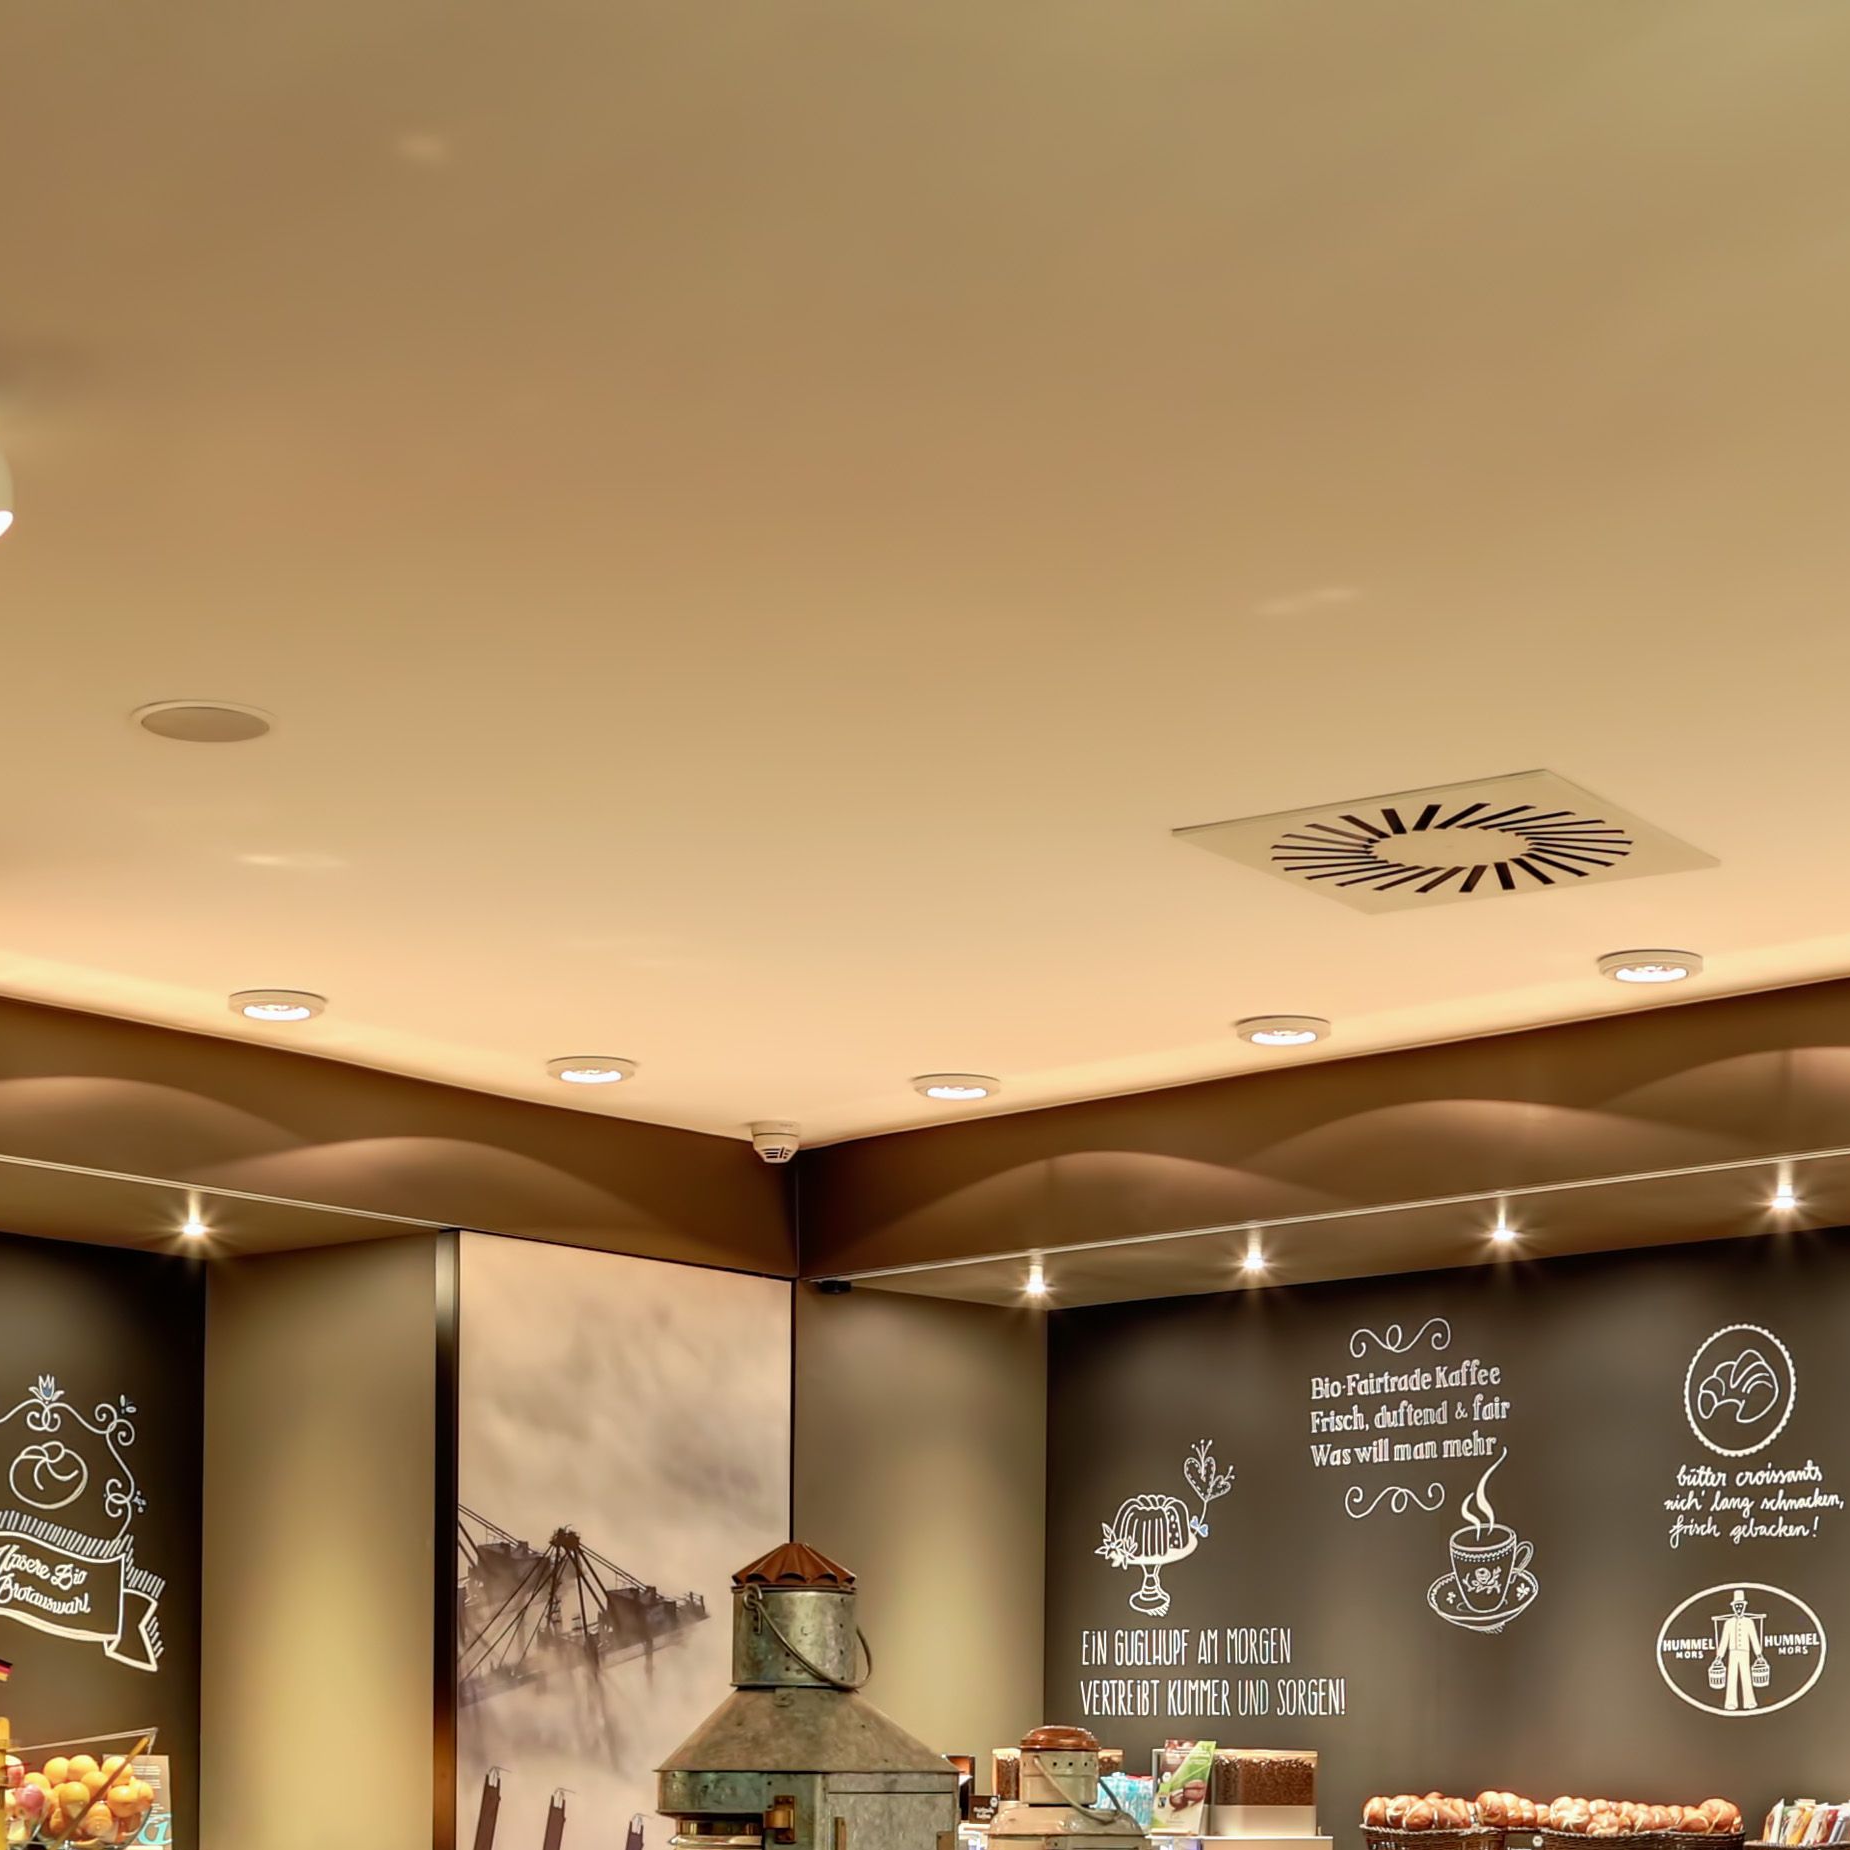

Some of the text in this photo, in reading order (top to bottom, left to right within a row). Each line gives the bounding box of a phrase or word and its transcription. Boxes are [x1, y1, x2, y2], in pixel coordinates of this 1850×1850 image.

[1435, 1358, 1501, 1389] Kaffee
[1310, 1393, 1511, 1433] Frisch, duftend & fair
[1310, 1429, 1497, 1467] Was will man mehr
[1735, 1459, 1823, 1487] croissants
[1710, 1490, 1755, 1519] lang
[1760, 1487, 1845, 1511] schnacken,
[1668, 1514, 1721, 1549] frisch
[50, 1563, 88, 1590] Bio
[1114, 1629, 1190, 1666] GUGLHUPF
[1198, 1628, 1218, 1665] AM
[1226, 1627, 1291, 1665] MORGEN
[1662, 1637, 1716, 1654] HUMMEL
[1675, 1649, 1704, 1660] MORS
[1764, 1632, 1820, 1648] HUMMEL
[1778, 1644, 1809, 1656] MORS
[1167, 1679, 1231, 1717] KUMMER
[1238, 1679, 1269, 1716] UND
[1277, 1677, 1346, 1716] SORGEN!
